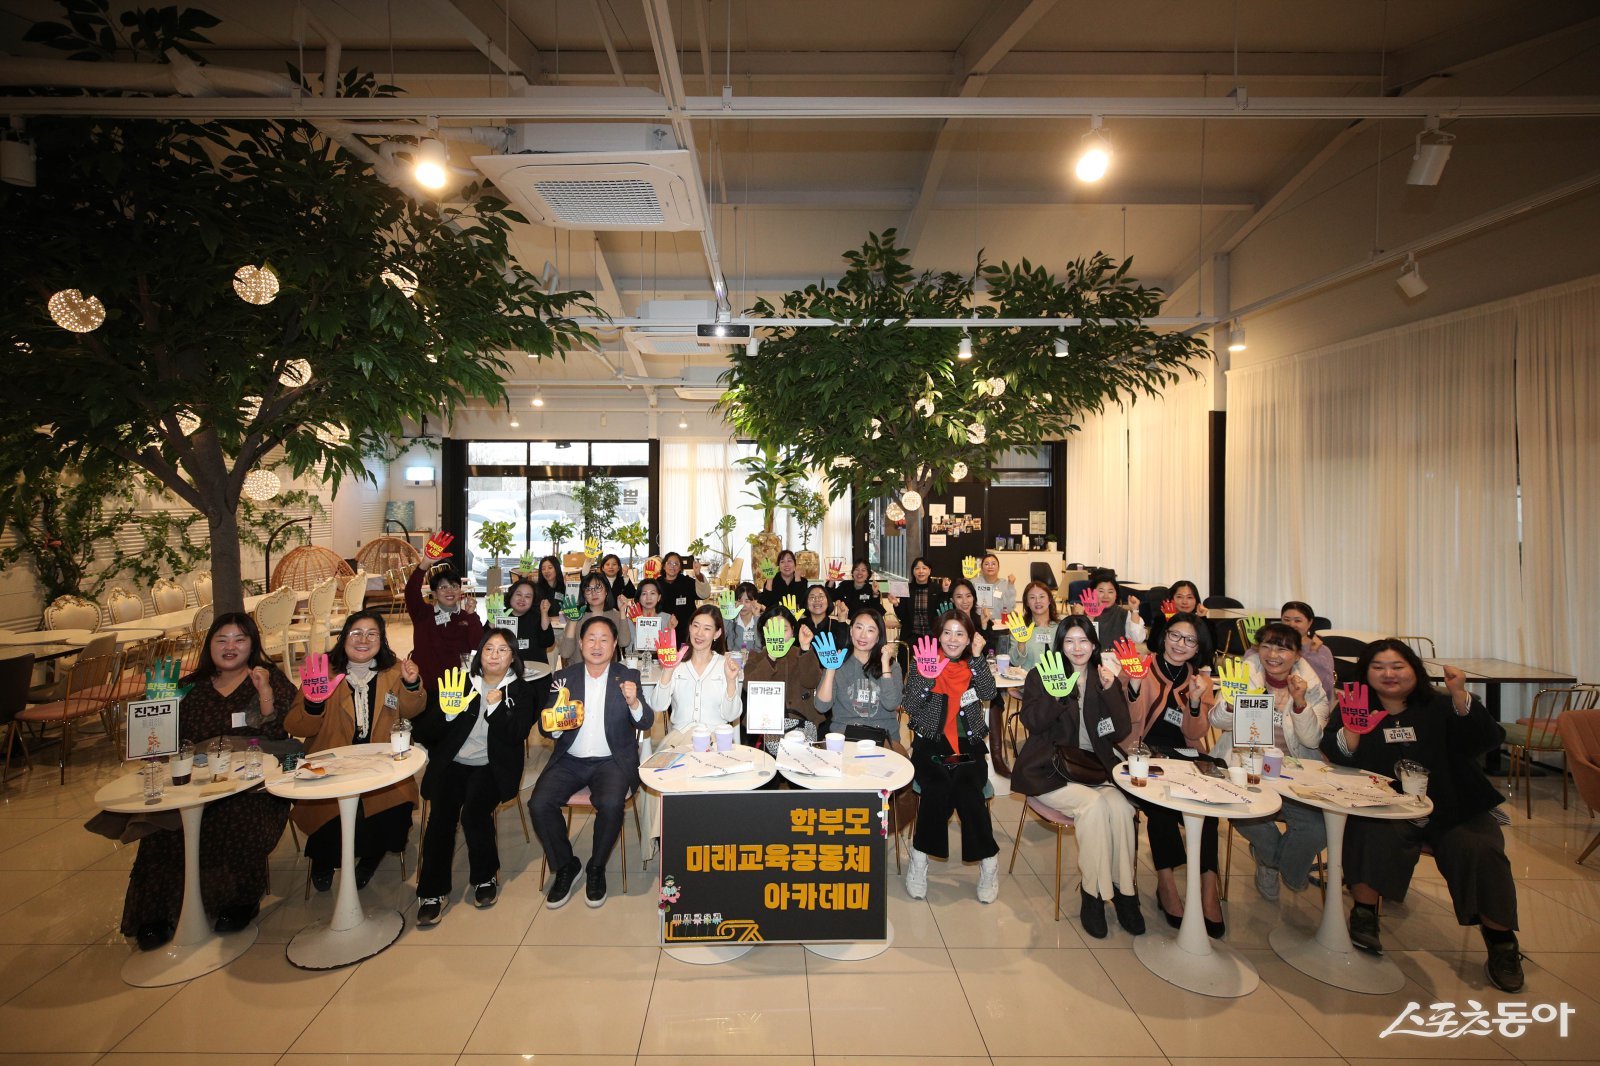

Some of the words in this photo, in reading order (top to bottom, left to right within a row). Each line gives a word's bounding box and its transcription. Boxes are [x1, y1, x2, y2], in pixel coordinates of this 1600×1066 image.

[771, 644, 784, 652] 시장
[664, 654, 676, 662] 시장
[818, 650, 837, 658] 학부모
[1121, 657, 1141, 665] 학부모
[1129, 665, 1143, 673] 시장
[303, 676, 328, 687] 학부모
[1042, 673, 1066, 682] 학부모
[147, 682, 177, 691] 학부모
[1051, 682, 1067, 690] 시장
[1221, 680, 1248, 690] 학부모
[310, 685, 328, 695] 시장
[440, 691, 462, 699] 학부모
[446, 699, 461, 708] 시장
[1239, 699, 1269, 709] 별내중
[134, 703, 172, 719] 진건고
[1341, 706, 1368, 718] 학부모
[1349, 717, 1368, 727] 시장
[790, 807, 871, 836] 학부모
[686, 843, 871, 873] 미래교육공동체
[764, 882, 870, 911] 아카데미
